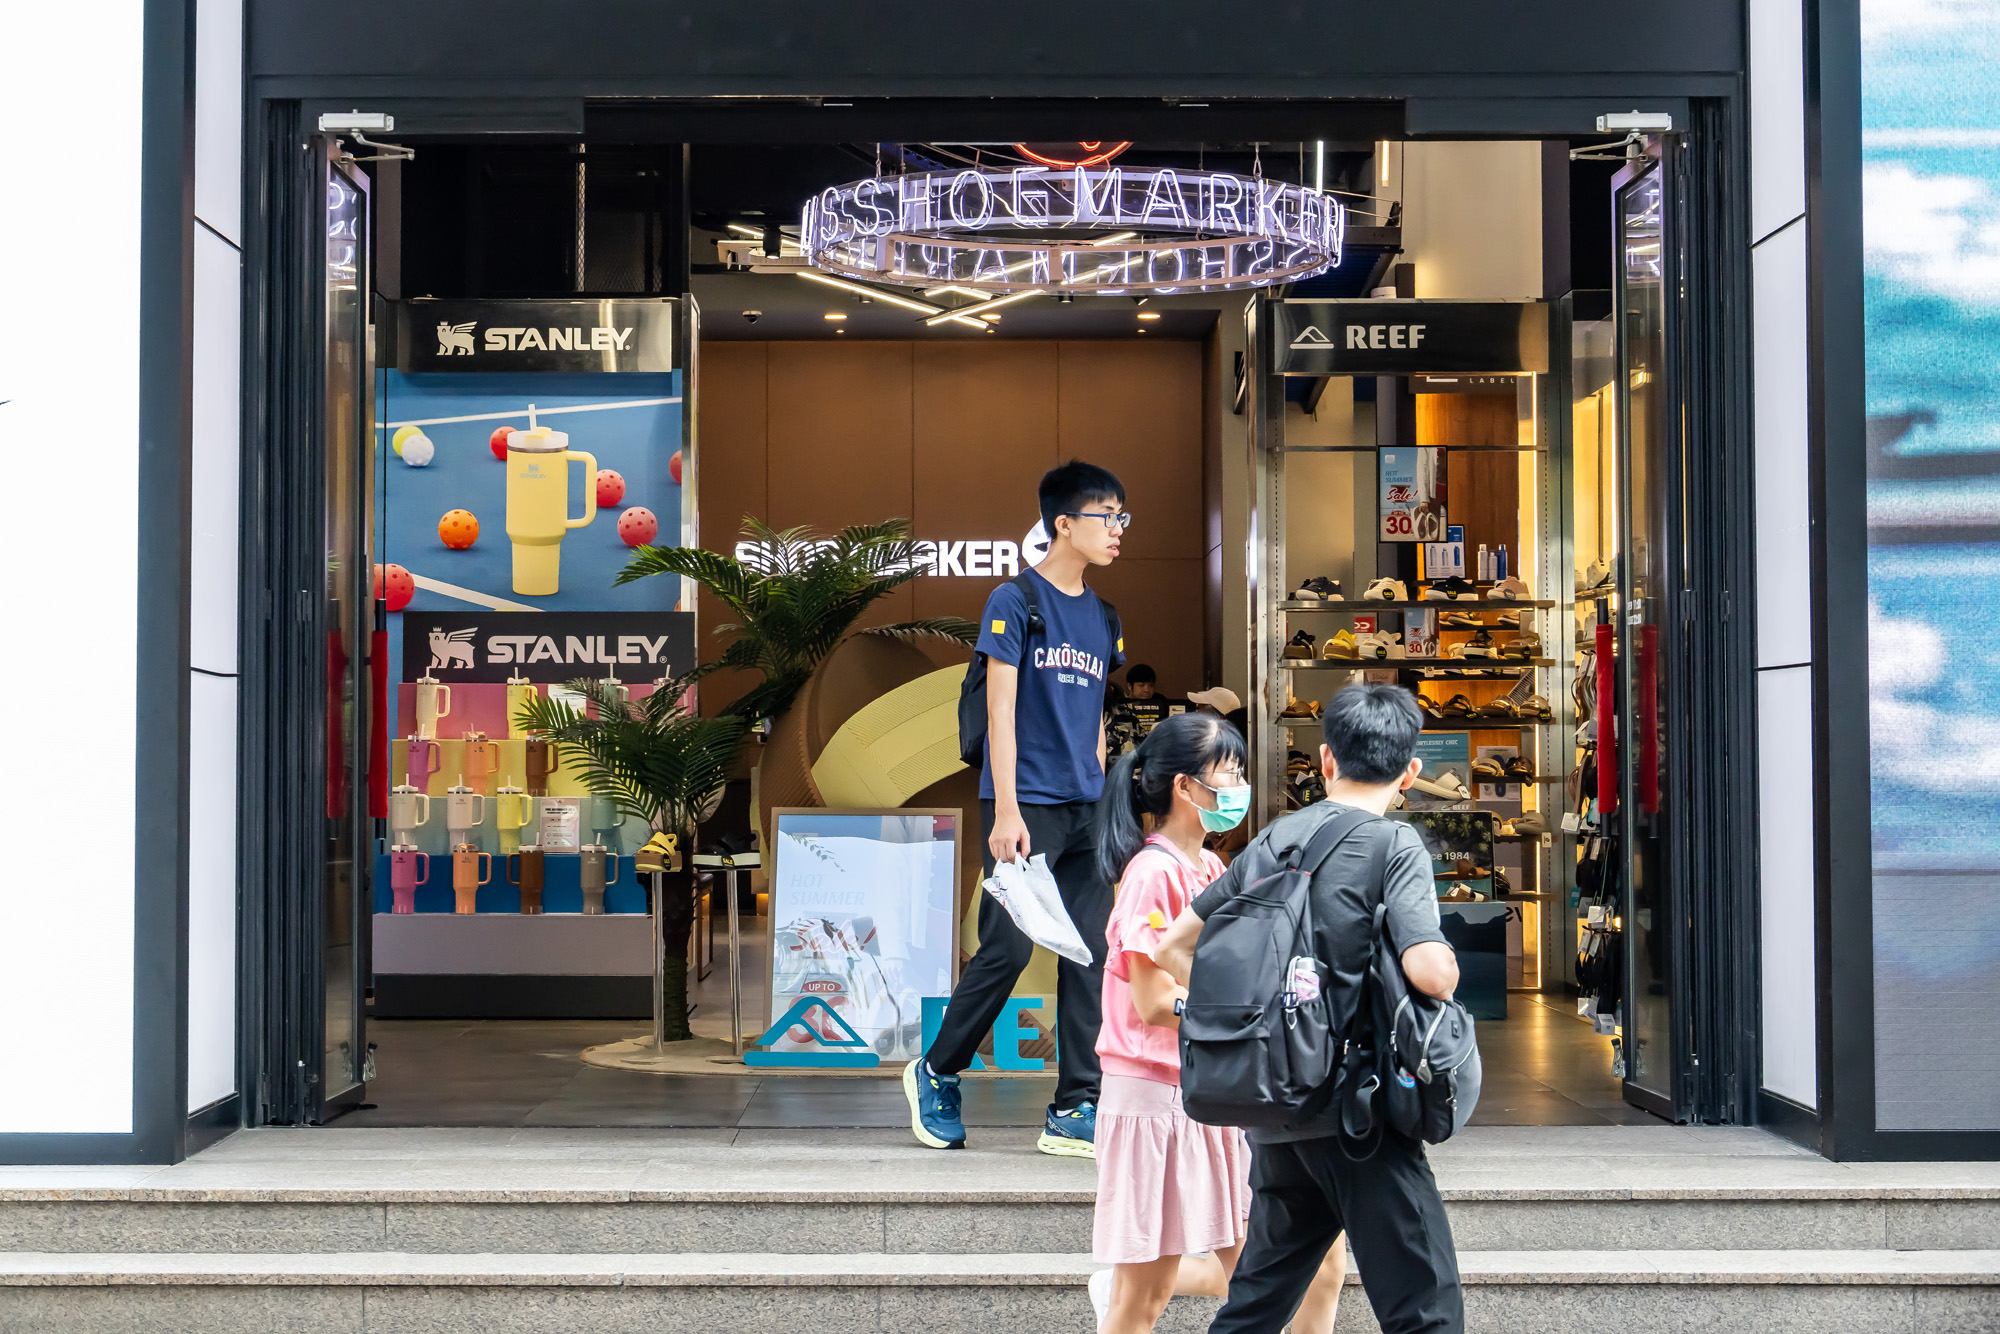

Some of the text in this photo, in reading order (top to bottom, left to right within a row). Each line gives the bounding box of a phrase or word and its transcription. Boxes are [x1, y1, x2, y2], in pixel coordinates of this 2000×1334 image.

[484, 327, 633, 350] STANLEY
[1346, 324, 1426, 350] REEF
[1386, 488, 1418, 500] Sale!
[487, 635, 669, 664] STANLEY
[1445, 852, 1470, 860] 1984
[790, 874, 825, 888] HOT
[789, 891, 865, 906] SUMMER
[809, 983, 835, 991] UP TO
